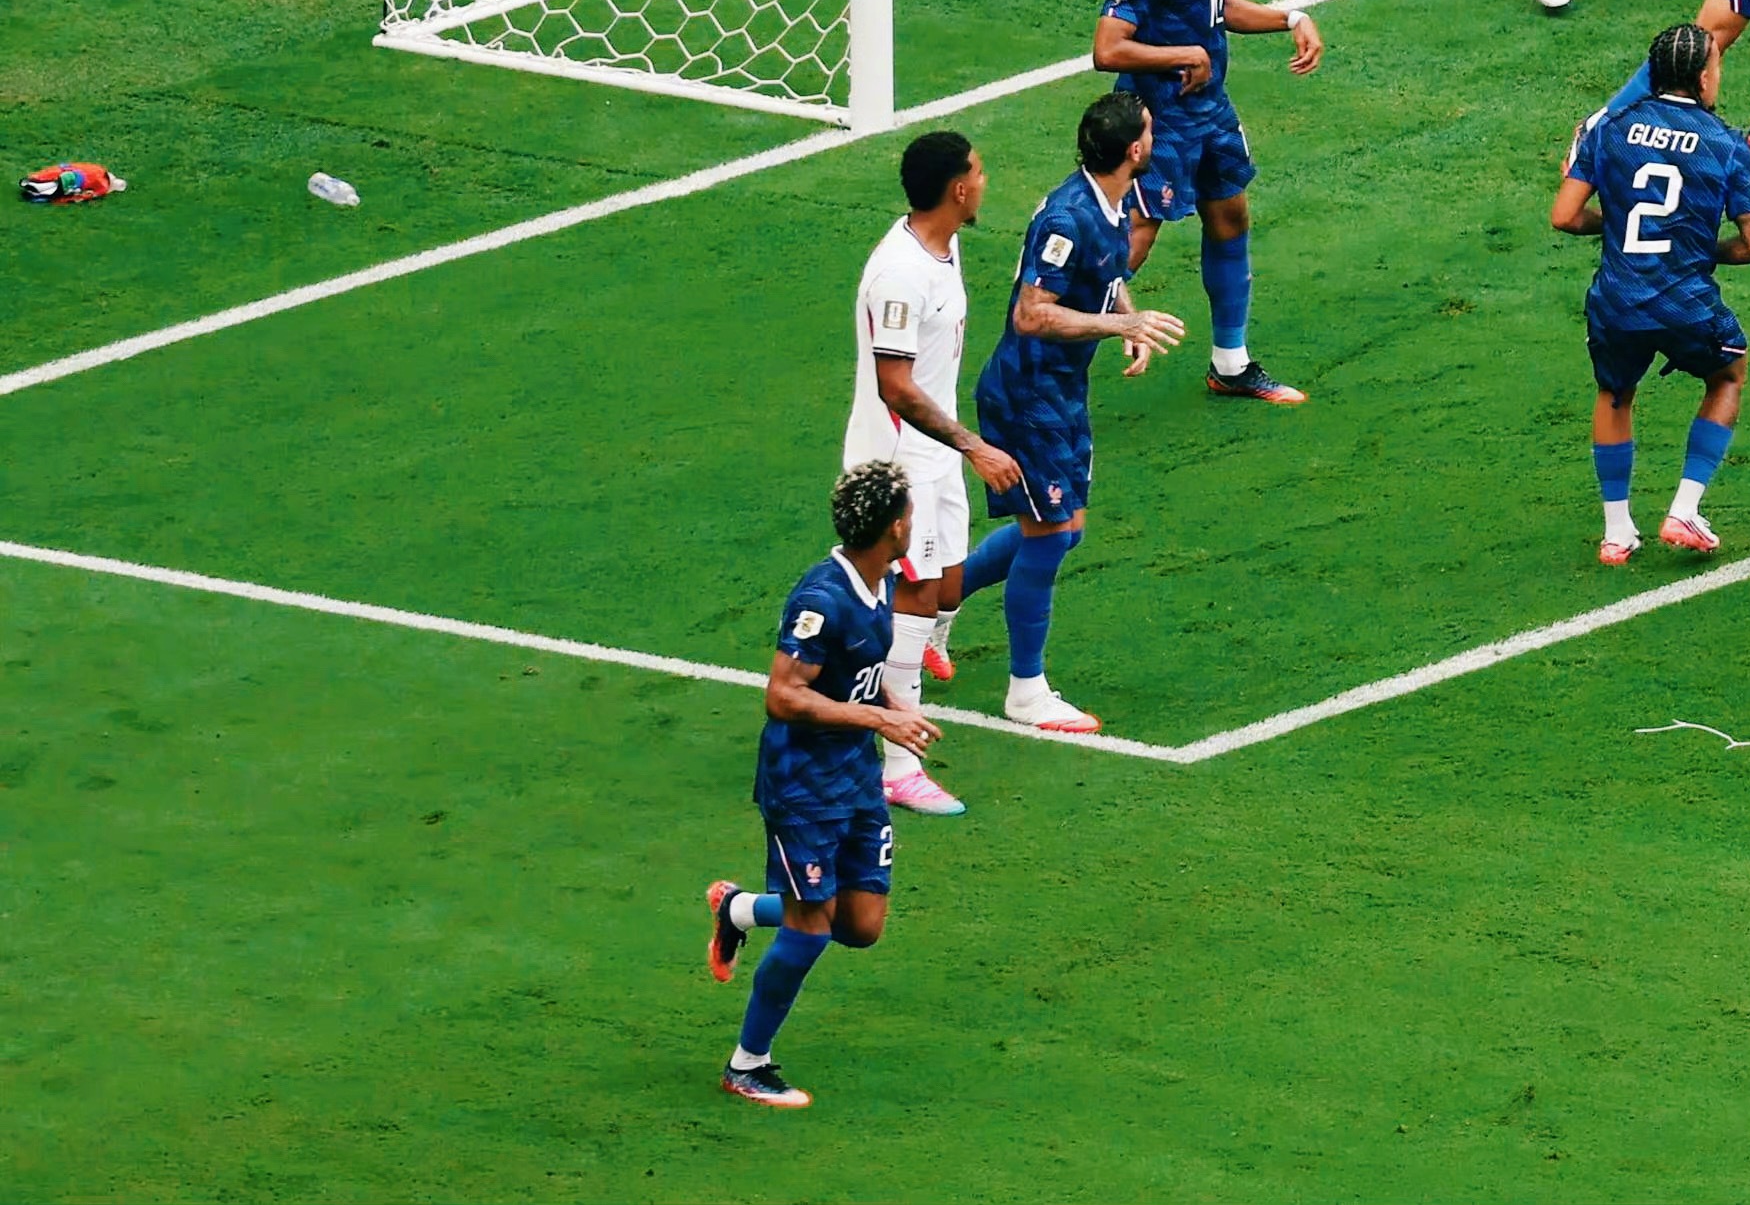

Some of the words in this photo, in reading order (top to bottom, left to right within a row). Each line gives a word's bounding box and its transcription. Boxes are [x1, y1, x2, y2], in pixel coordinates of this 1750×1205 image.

[1627, 122, 1700, 154] GUSTO
[1622, 162, 1684, 254] 2
[849, 661, 885, 704] 20
